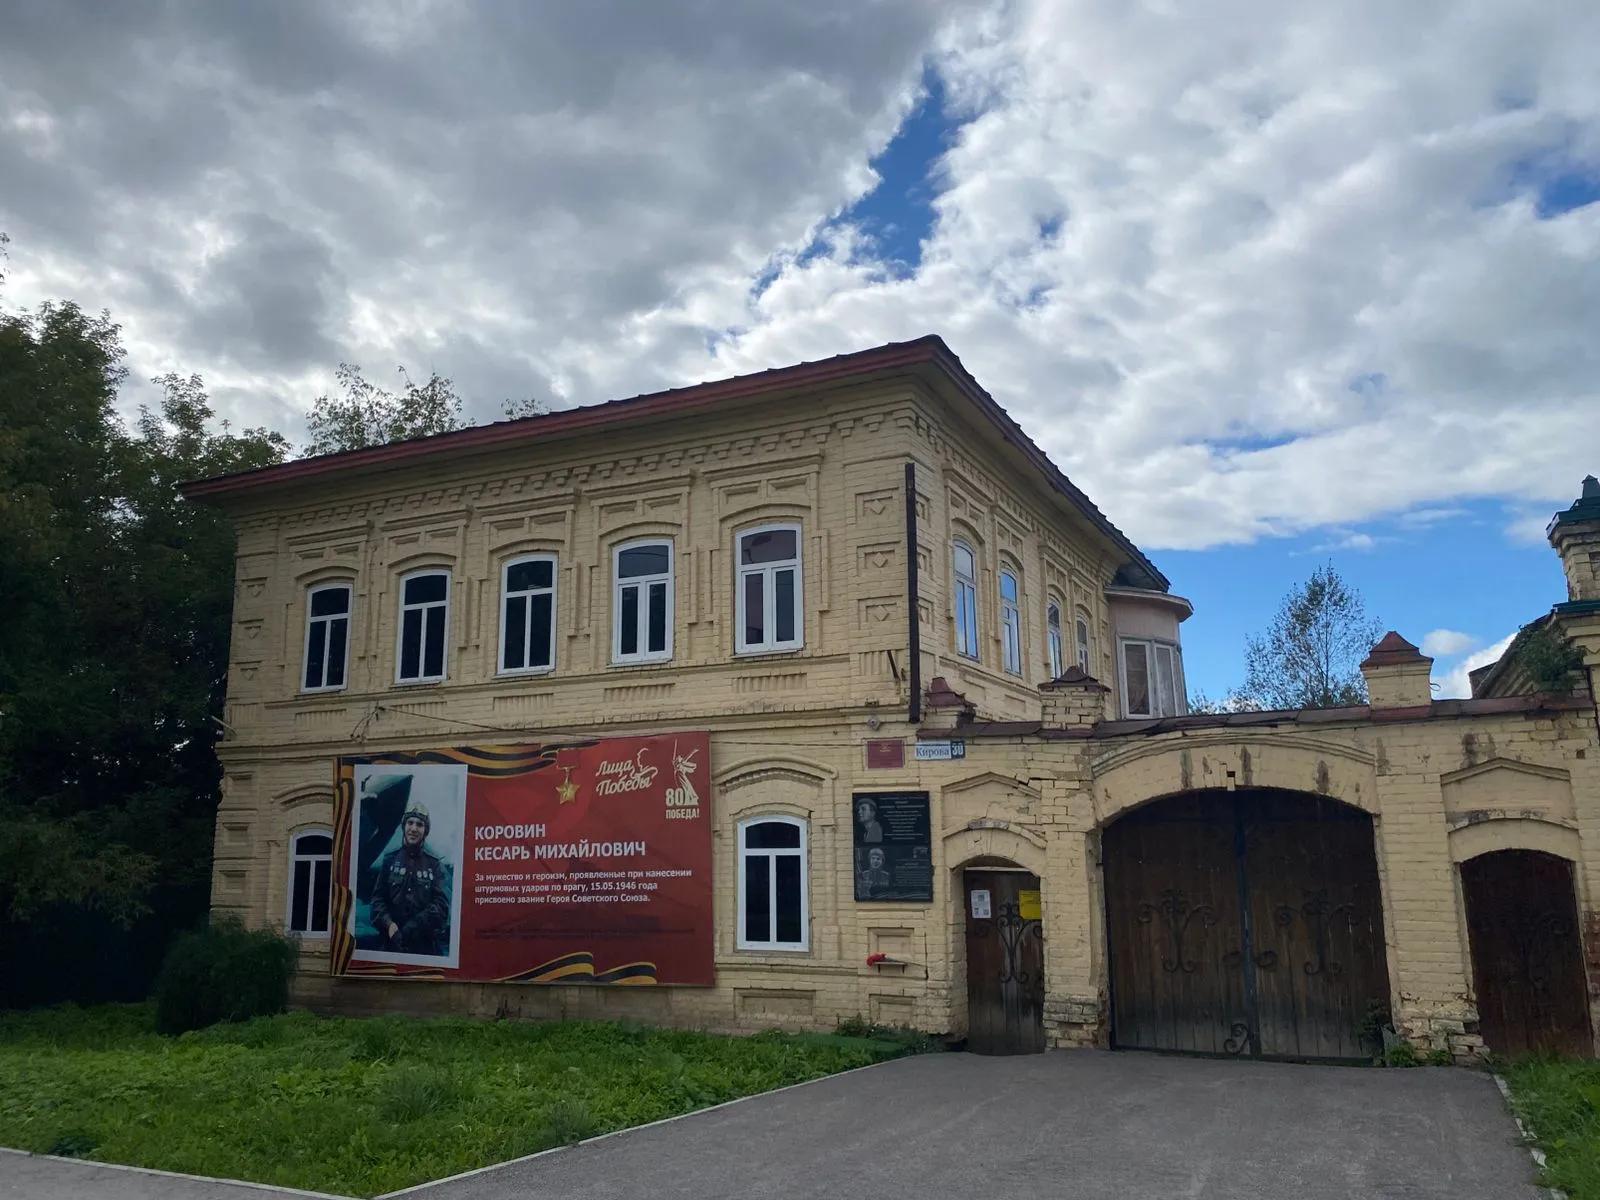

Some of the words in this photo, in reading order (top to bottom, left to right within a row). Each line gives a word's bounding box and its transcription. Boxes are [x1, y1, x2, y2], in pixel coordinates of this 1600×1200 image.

[916, 747, 949, 757] Кирова
[596, 760, 634, 776] Лица
[596, 775, 652, 796] Победы
[666, 808, 700, 819] ПОБЕДА!
[475, 824, 546, 840] КОРОВИН
[475, 846, 530, 861] КЕСАРЬ
[535, 840, 646, 860] МИХАЙЛОВИЧ
[486, 873, 524, 882] мужество
[533, 873, 568, 882] героизм,
[569, 871, 625, 880] проявленные
[628, 872, 643, 880] при
[645, 869, 692, 877] нанесении
[475, 885, 519, 894] штурмовых
[522, 884, 549, 893] ударов
[563, 884, 589, 892] врагу,
[591, 882, 636, 890] 15.05.1946
[475, 896, 515, 905] присвоено
[547, 896, 569, 904] Героя
